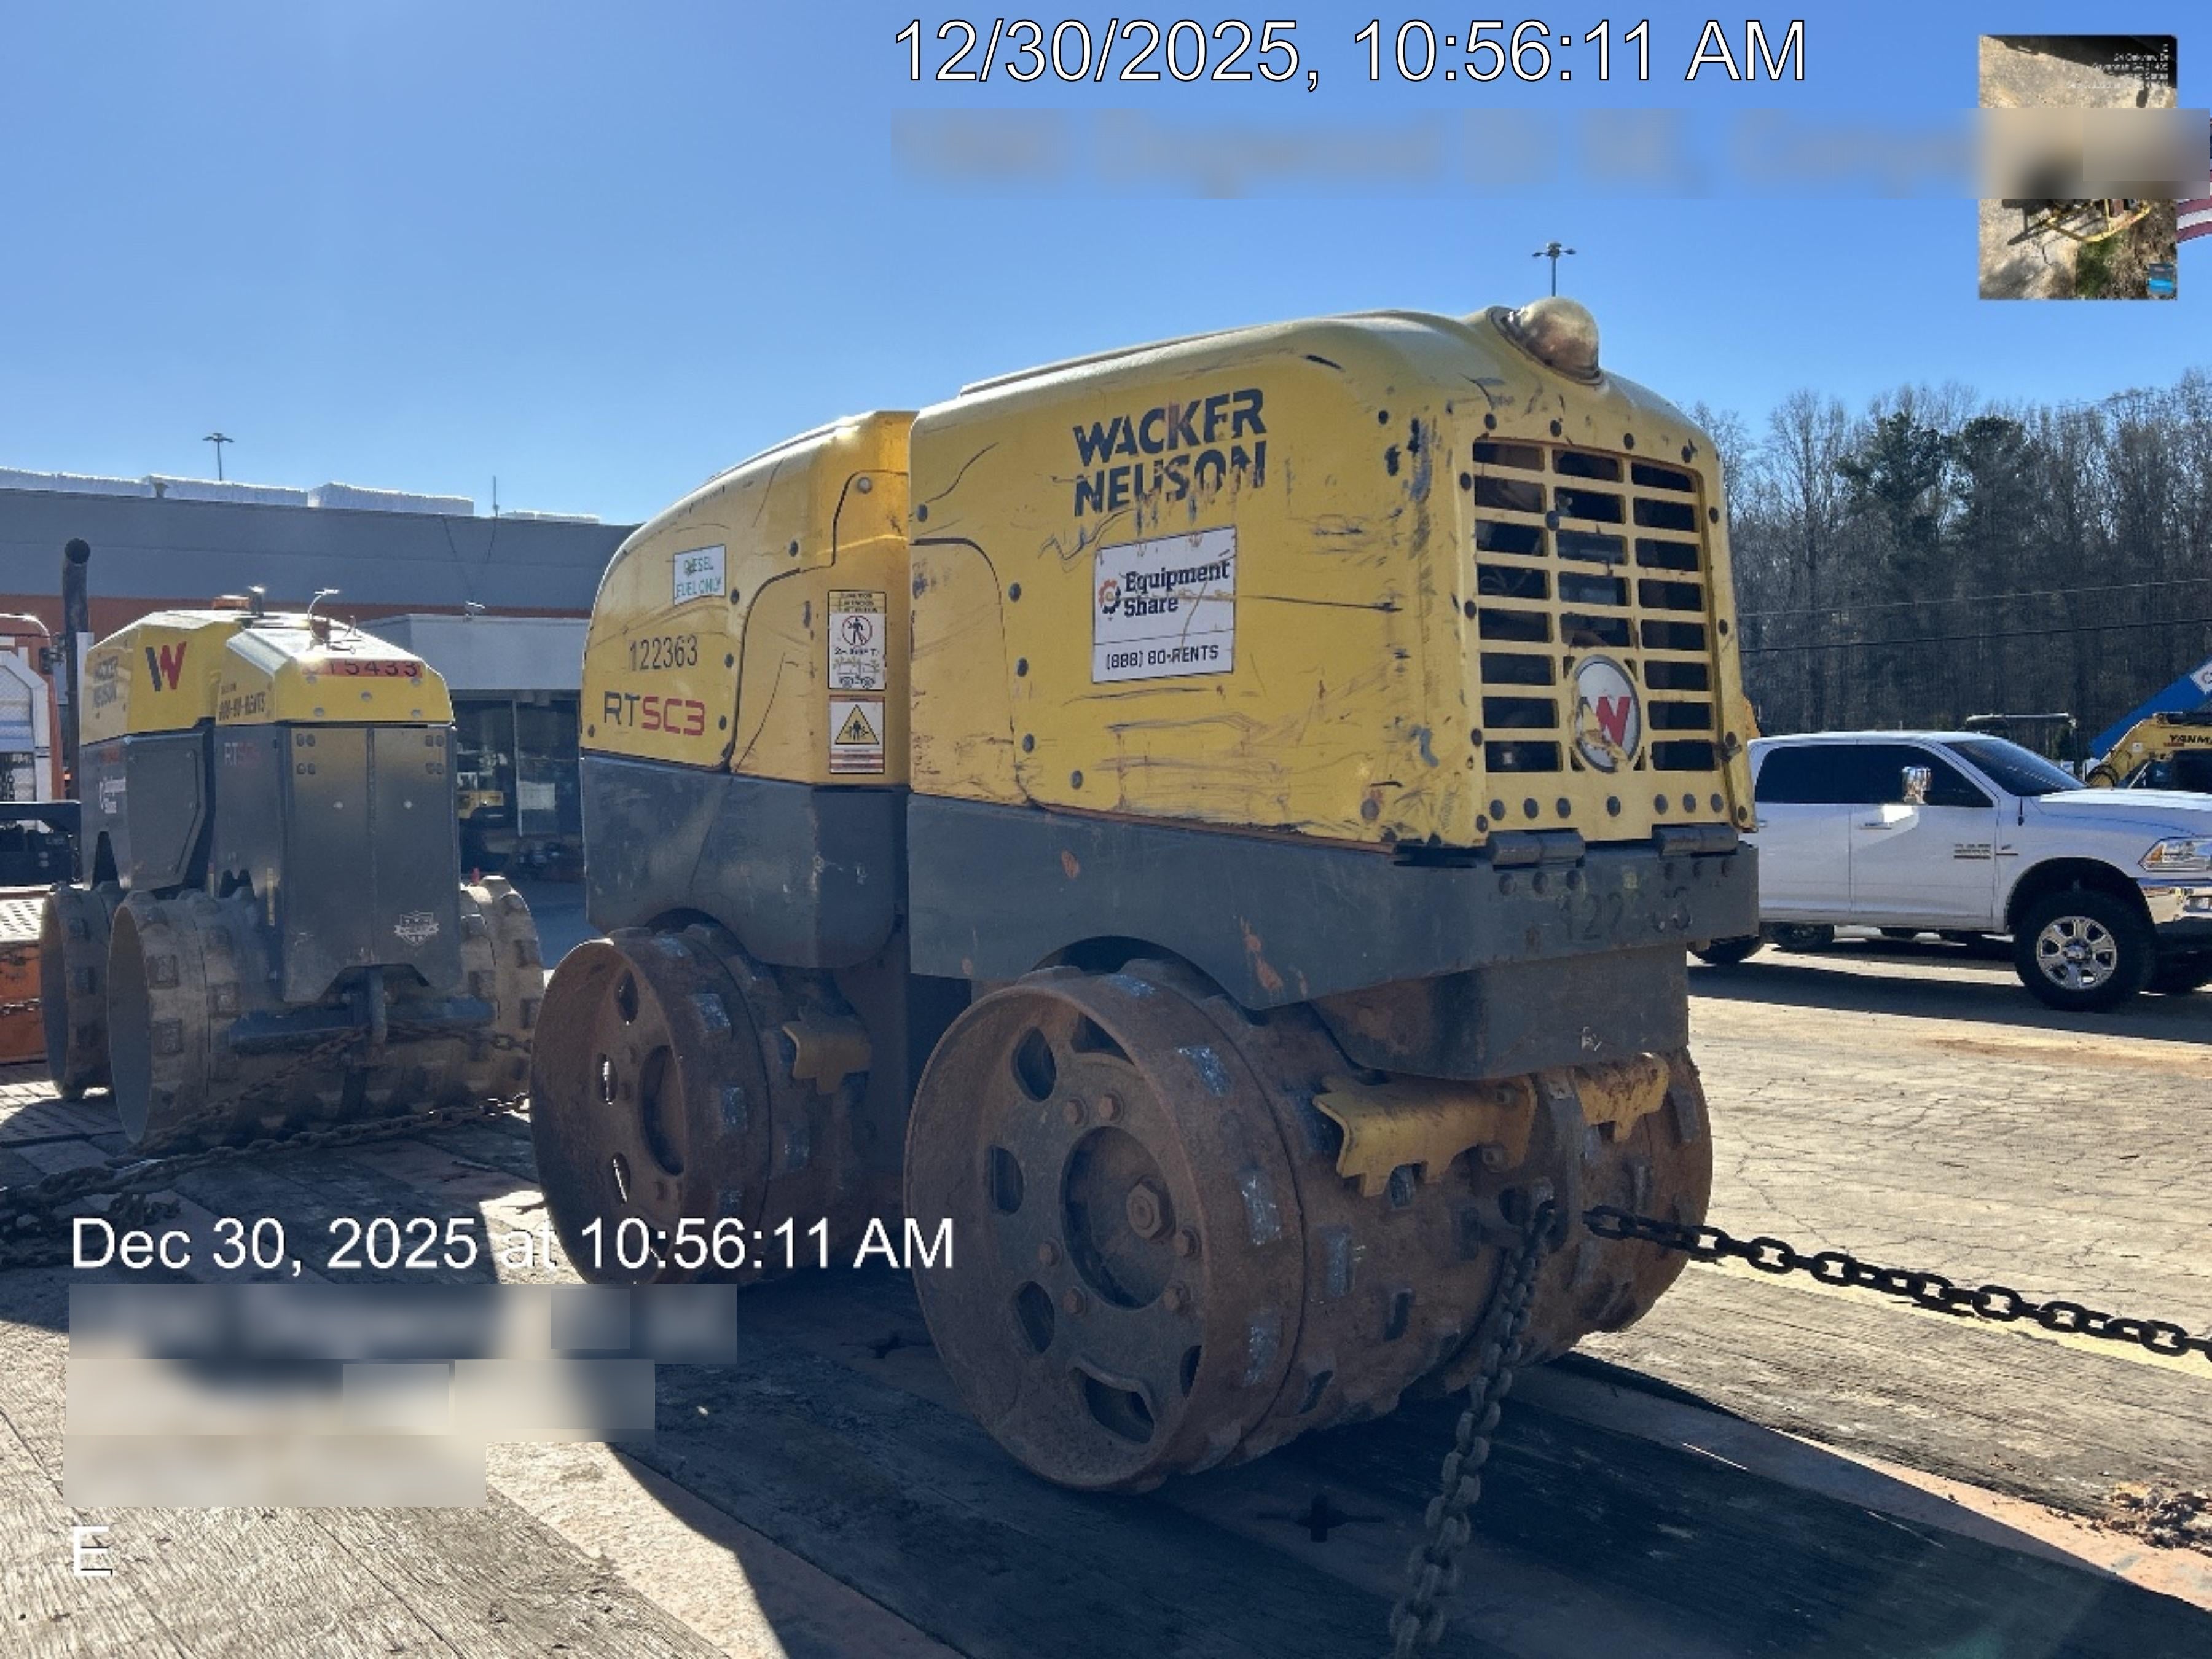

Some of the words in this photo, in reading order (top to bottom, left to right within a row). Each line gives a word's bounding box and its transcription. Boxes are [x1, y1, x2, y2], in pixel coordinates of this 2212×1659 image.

[1073, 388, 1266, 466] WACKER
[1075, 440, 1266, 516] NEUSON
[1125, 560, 1230, 595] Equipment
[1124, 595, 1179, 617] Share
[629, 634, 698, 672] 122363
[1107, 650, 1143, 670] (888)
[1148, 645, 1220, 665] 80-RENTS
[604, 691, 705, 736] RTSC3
[2170, 735, 2212, 743] YANM
